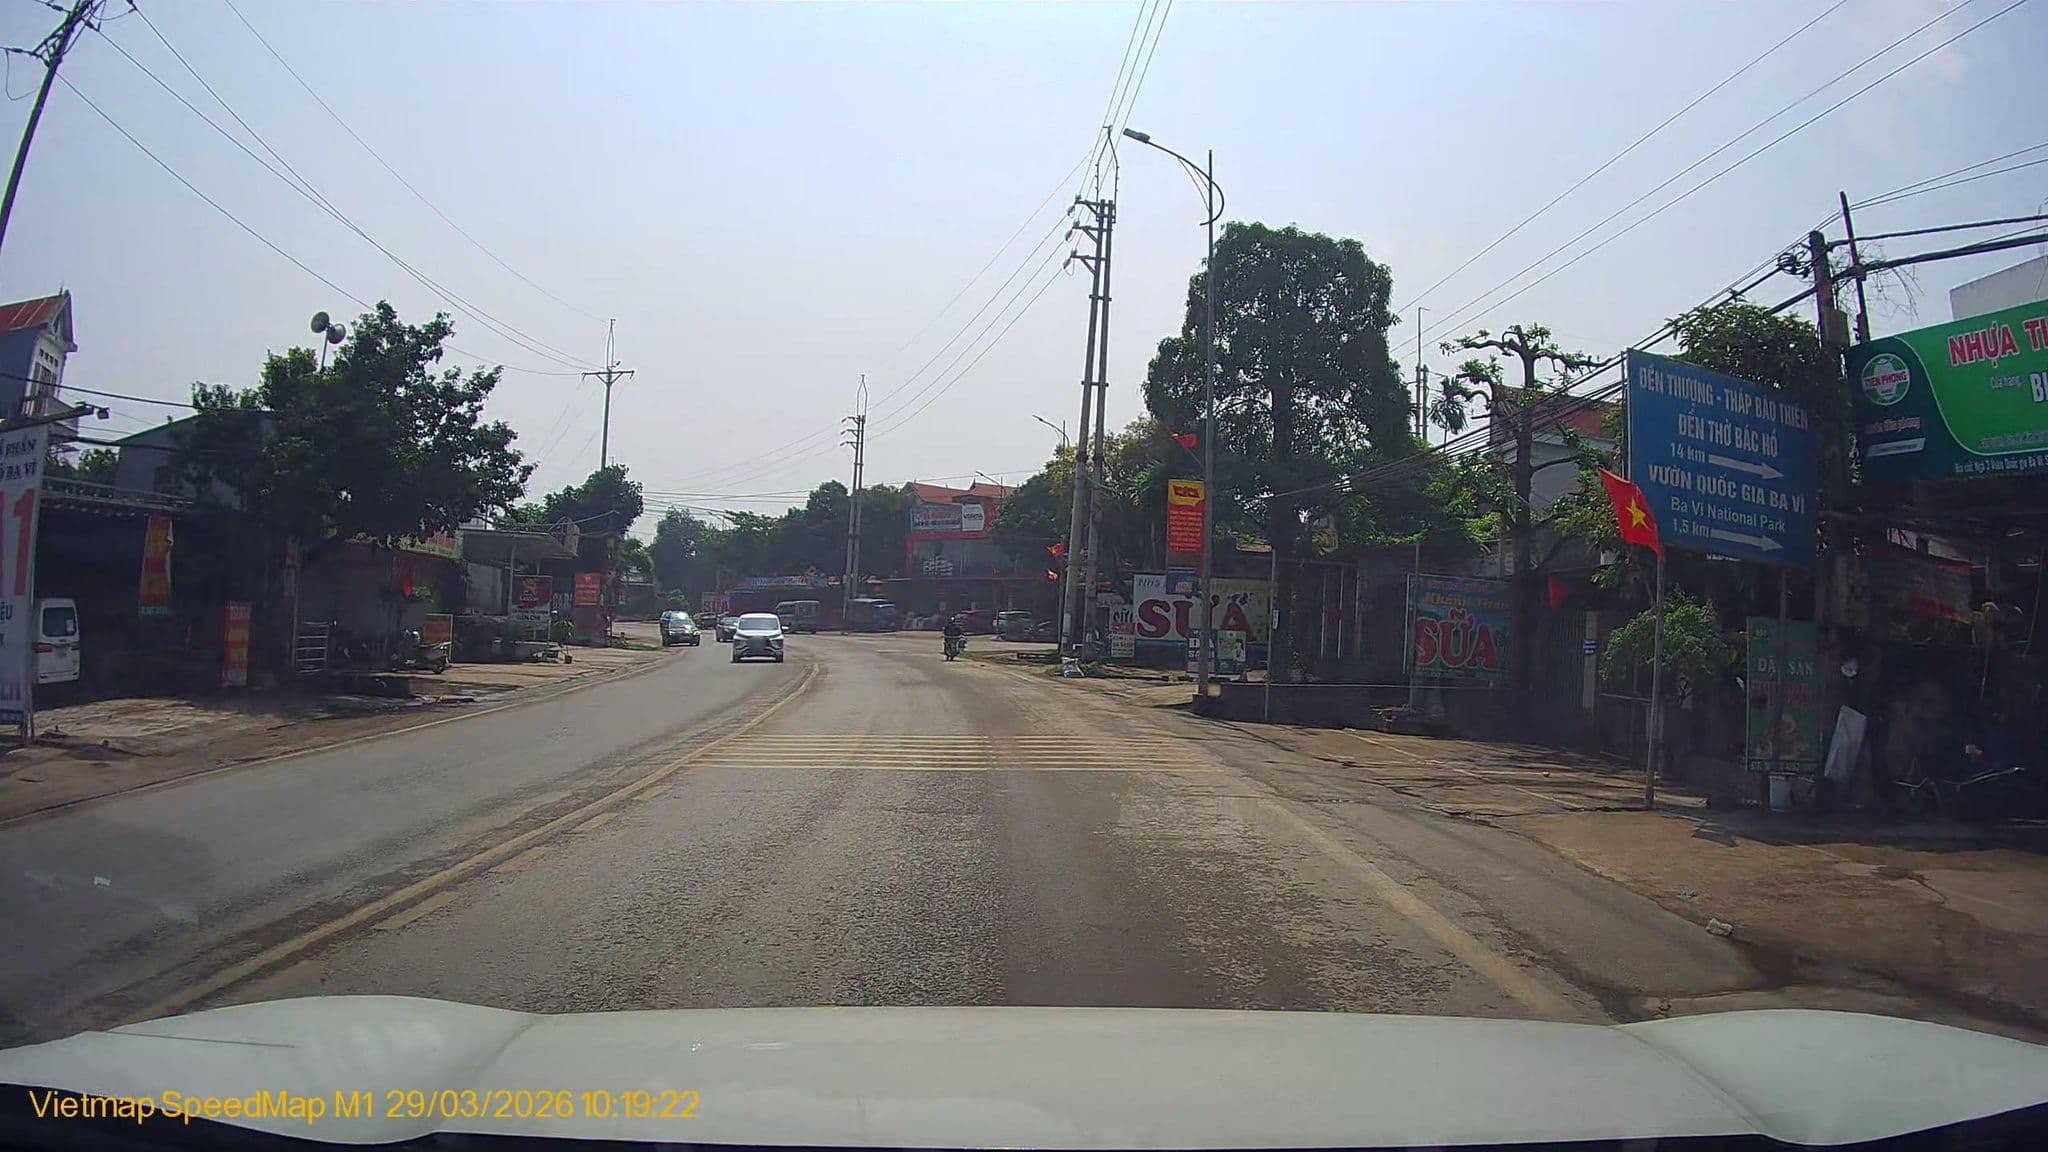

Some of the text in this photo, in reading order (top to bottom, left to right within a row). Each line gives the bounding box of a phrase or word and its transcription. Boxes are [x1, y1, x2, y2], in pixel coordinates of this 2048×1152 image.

[1948, 320, 2020, 368] NHỰA
[1724, 387, 1752, 415] THÁP
[1670, 442, 1706, 463] 14 km
[1708, 418, 1731, 446] THỜ
[1735, 424, 1759, 453] BÁC
[1648, 463, 1692, 490] VƯỜN
[1697, 473, 1737, 499] QUỐC
[1741, 484, 1766, 505] GIA
[1770, 490, 1789, 511] BA
[1671, 496, 1688, 513] Ba
[1708, 503, 1757, 528] National
[1760, 515, 1786, 533] Park
[1692, 520, 1711, 538] km
[1413, 607, 1498, 670] SỮA
